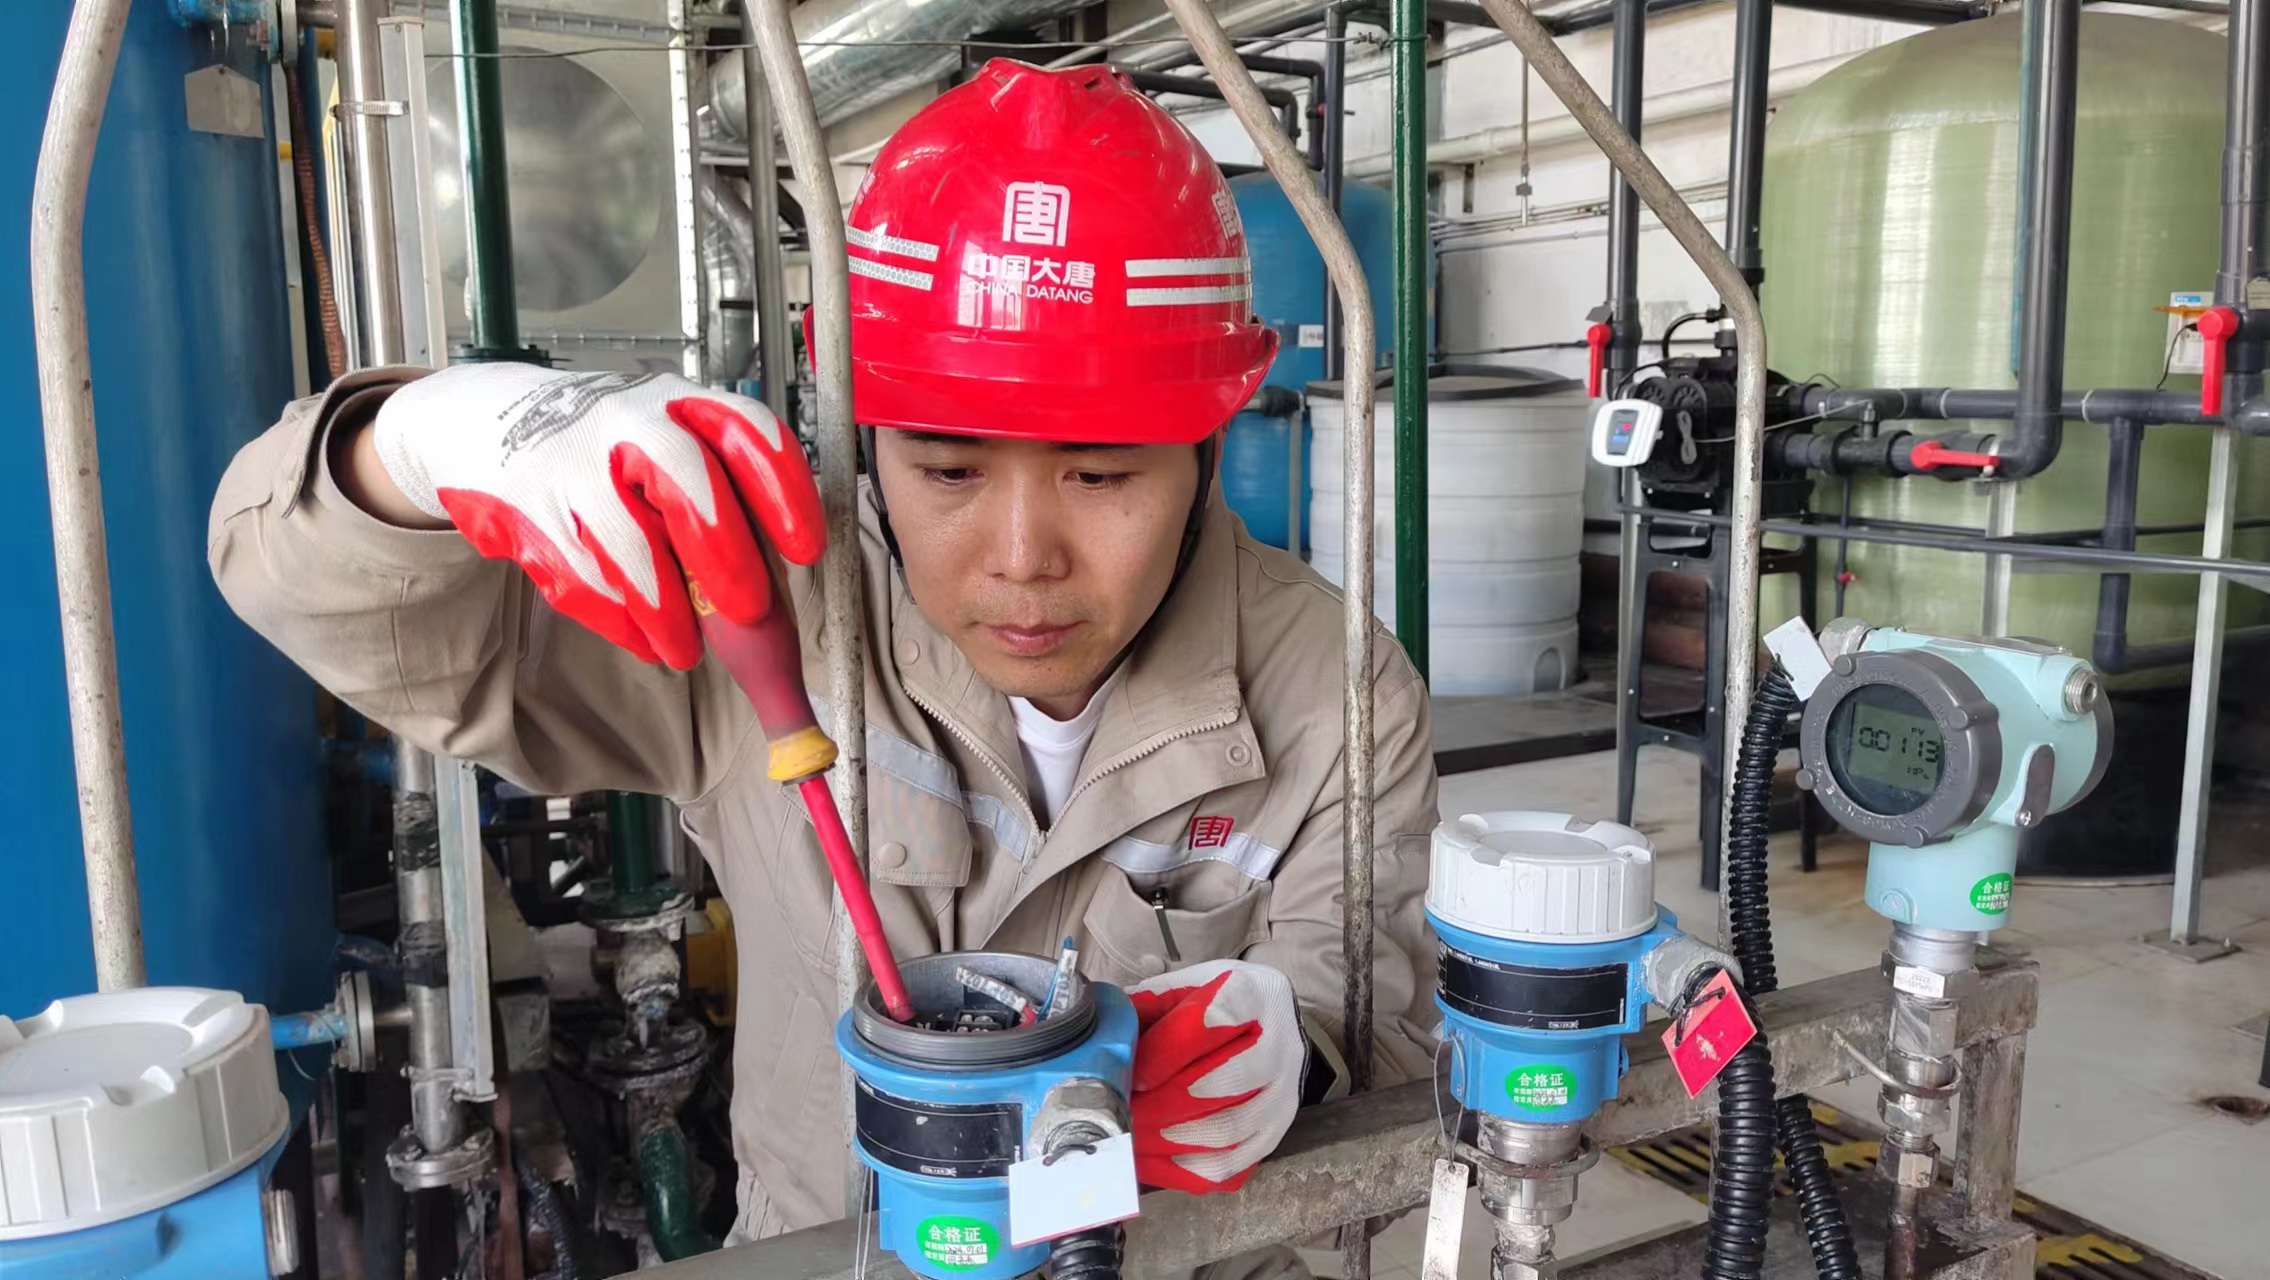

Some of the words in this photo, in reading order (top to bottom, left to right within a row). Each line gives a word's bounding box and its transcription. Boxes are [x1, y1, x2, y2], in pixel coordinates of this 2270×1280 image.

[967, 253, 1096, 289] 中国大唐
[969, 281, 1020, 297] CHINA
[1026, 285, 1094, 305] DATANG
[1517, 1072, 1564, 1087] 合格证
[928, 1224, 982, 1243] 合格证
